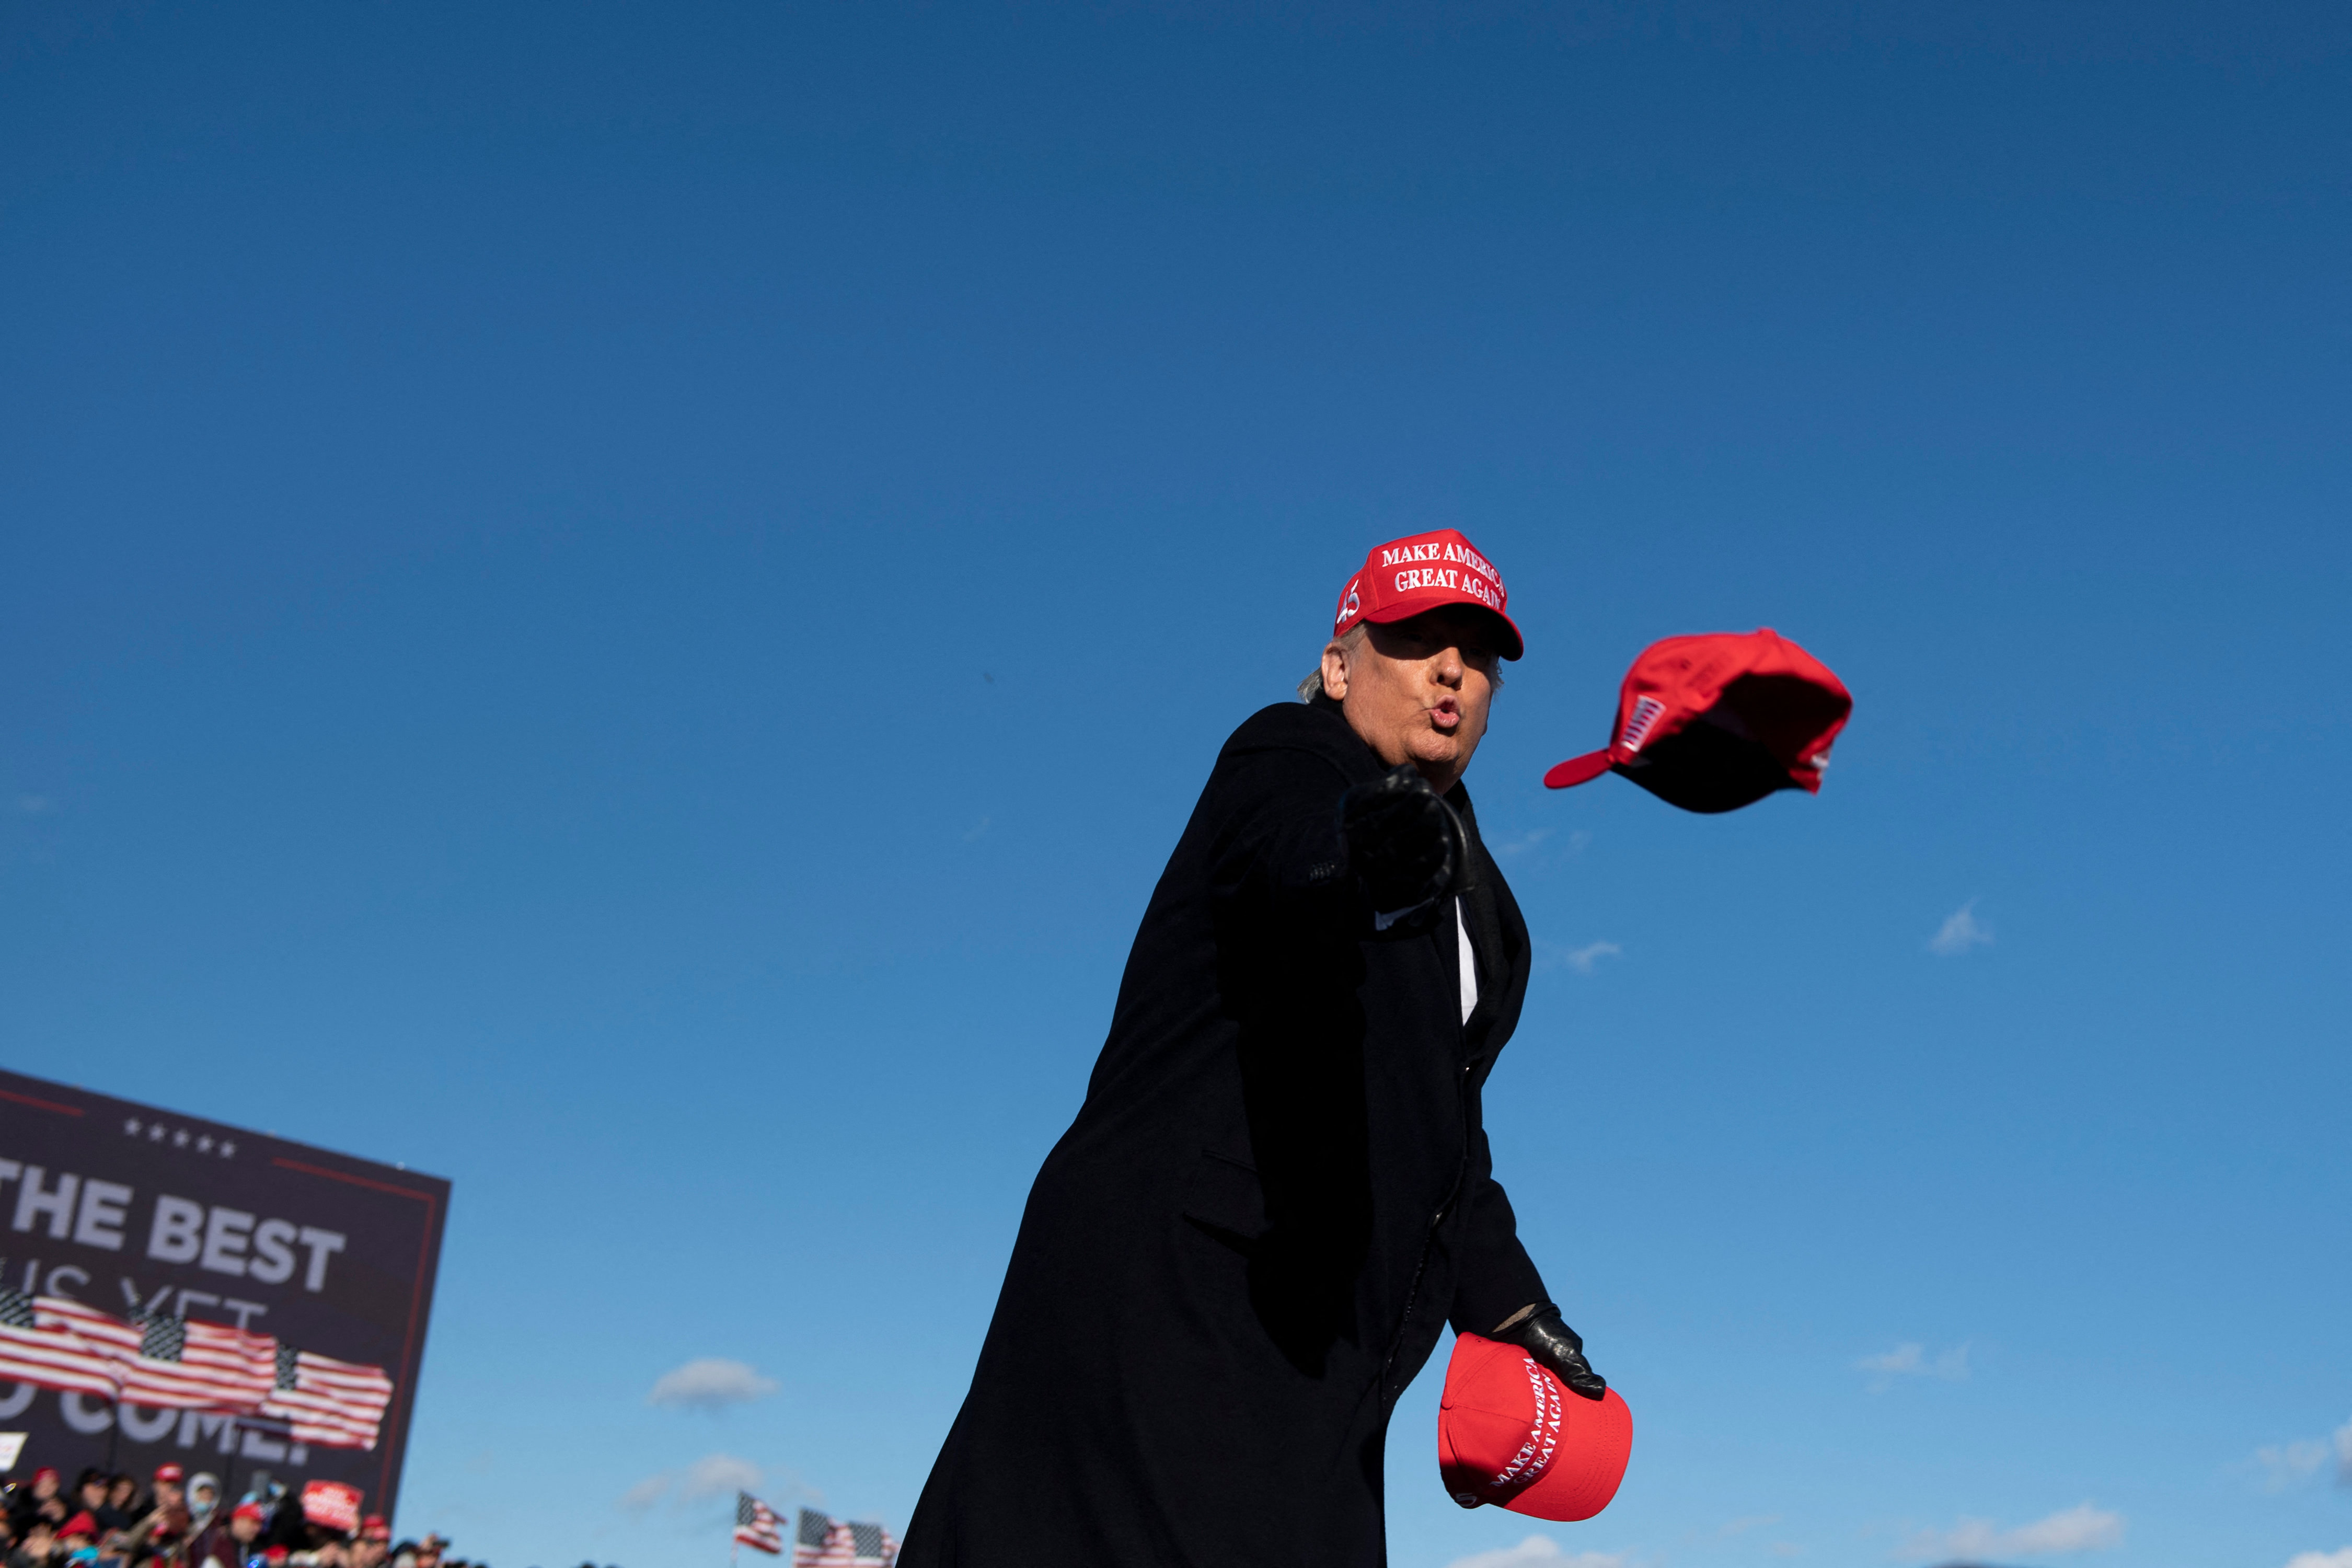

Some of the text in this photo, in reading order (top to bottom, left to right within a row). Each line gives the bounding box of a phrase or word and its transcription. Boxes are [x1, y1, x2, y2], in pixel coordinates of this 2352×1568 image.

[1381, 542, 1505, 598] MAKE AMERICA
[1394, 568, 1501, 610] GREAT AGAIN
[1336, 579, 1361, 624] 45
[146, 1194, 347, 1293] BEST
[1490, 1357, 1546, 1487] MAKE AMERICA
[1513, 1433, 1557, 1484] GREAT
